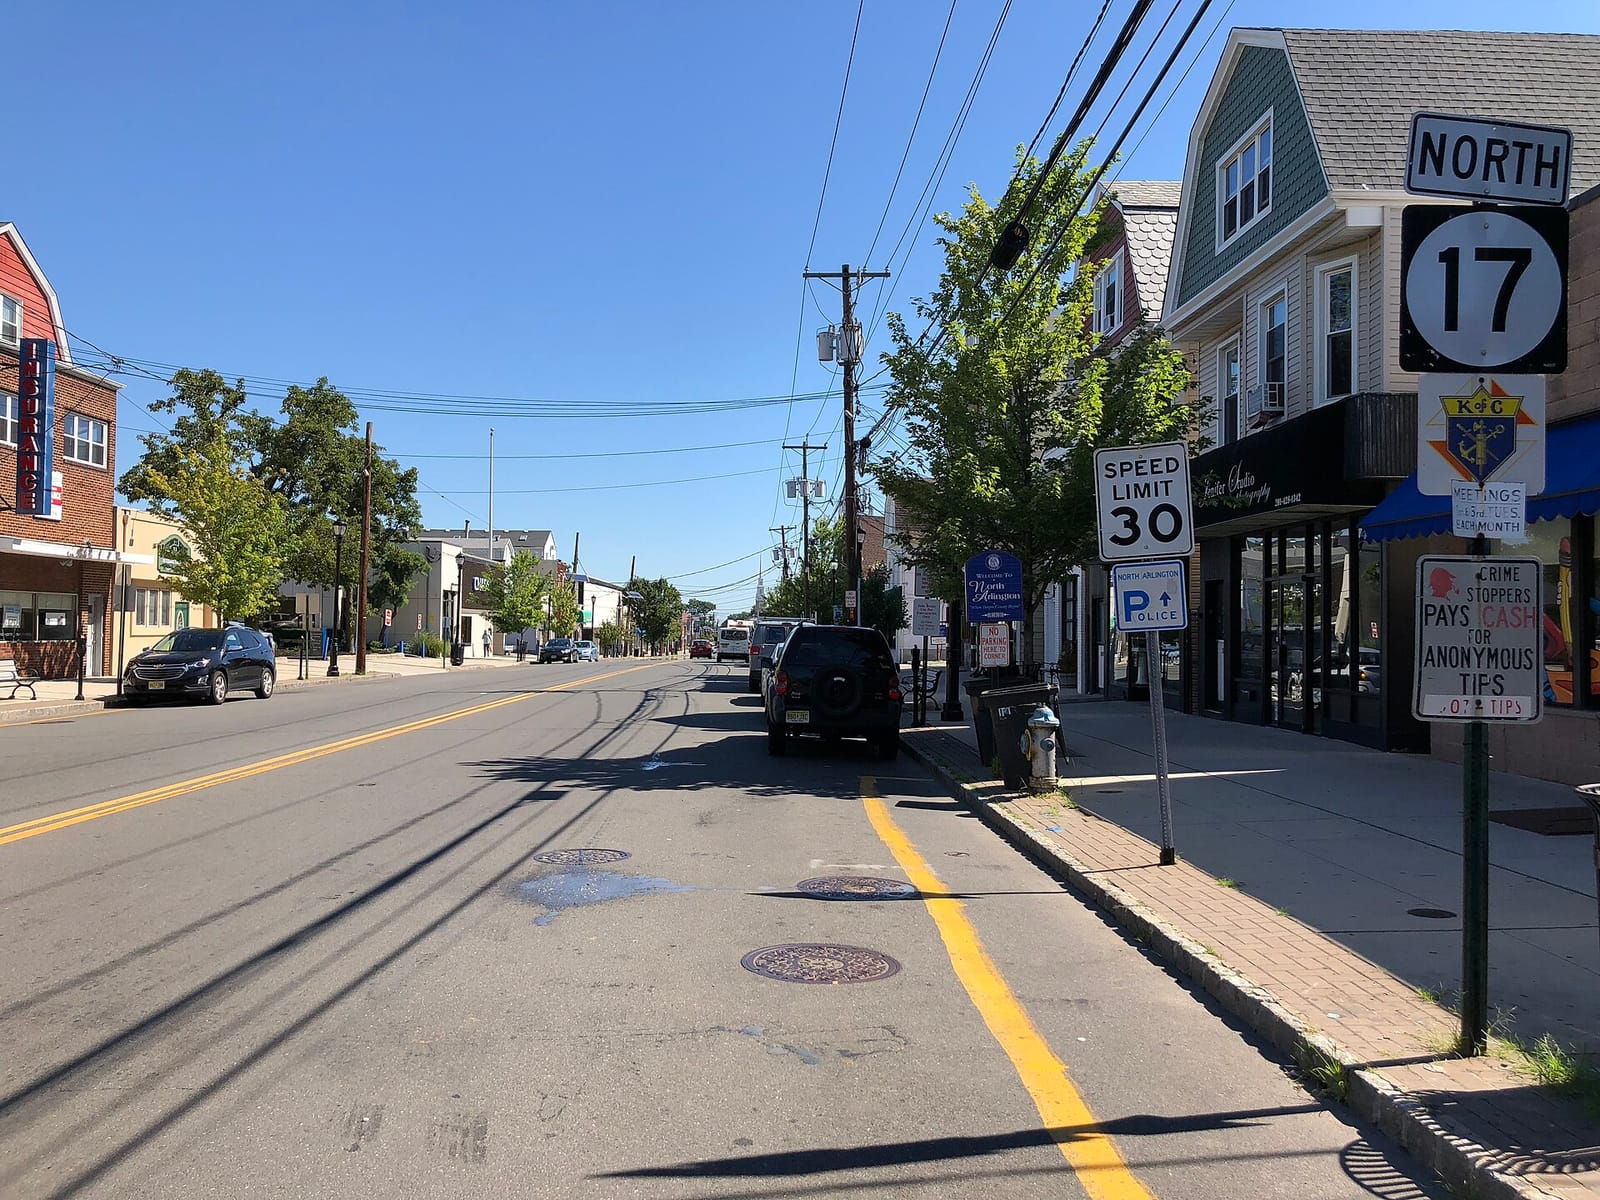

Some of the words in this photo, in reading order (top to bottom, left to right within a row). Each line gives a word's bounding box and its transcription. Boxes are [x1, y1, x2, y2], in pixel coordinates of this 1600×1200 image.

[1418, 131, 1561, 189] NORTH
[1438, 246, 1532, 333] 17
[1457, 399, 1473, 414] K
[1474, 398, 1487, 413] of
[1490, 399, 1504, 414] C
[19, 342, 41, 511] INSURANCE
[1104, 457, 1180, 479] SPEED
[1112, 480, 1173, 501] LIMIT
[1453, 488, 1521, 502] MEETINGS
[1108, 503, 1183, 546] 30
[1456, 519, 1475, 531] EACH
[1477, 521, 1520, 532] MONTH
[1118, 573, 1140, 582] NORTH
[1143, 569, 1179, 580] ARLINGTON
[1480, 566, 1520, 582] CRIME
[968, 580, 1005, 593] North
[972, 590, 1021, 602] Arlington
[1467, 587, 1531, 603] STOPPERS
[1123, 590, 1177, 622] POLICE
[1424, 604, 1470, 626] PAYS
[1482, 606, 1536, 629] CASH
[988, 627, 1000, 636] NO
[1468, 629, 1491, 644] FOR
[982, 637, 1007, 646] PARKING
[1423, 646, 1534, 670] ANONYMOUS
[1459, 673, 1505, 696] TIPS
[1490, 700, 1523, 715] TIPS
